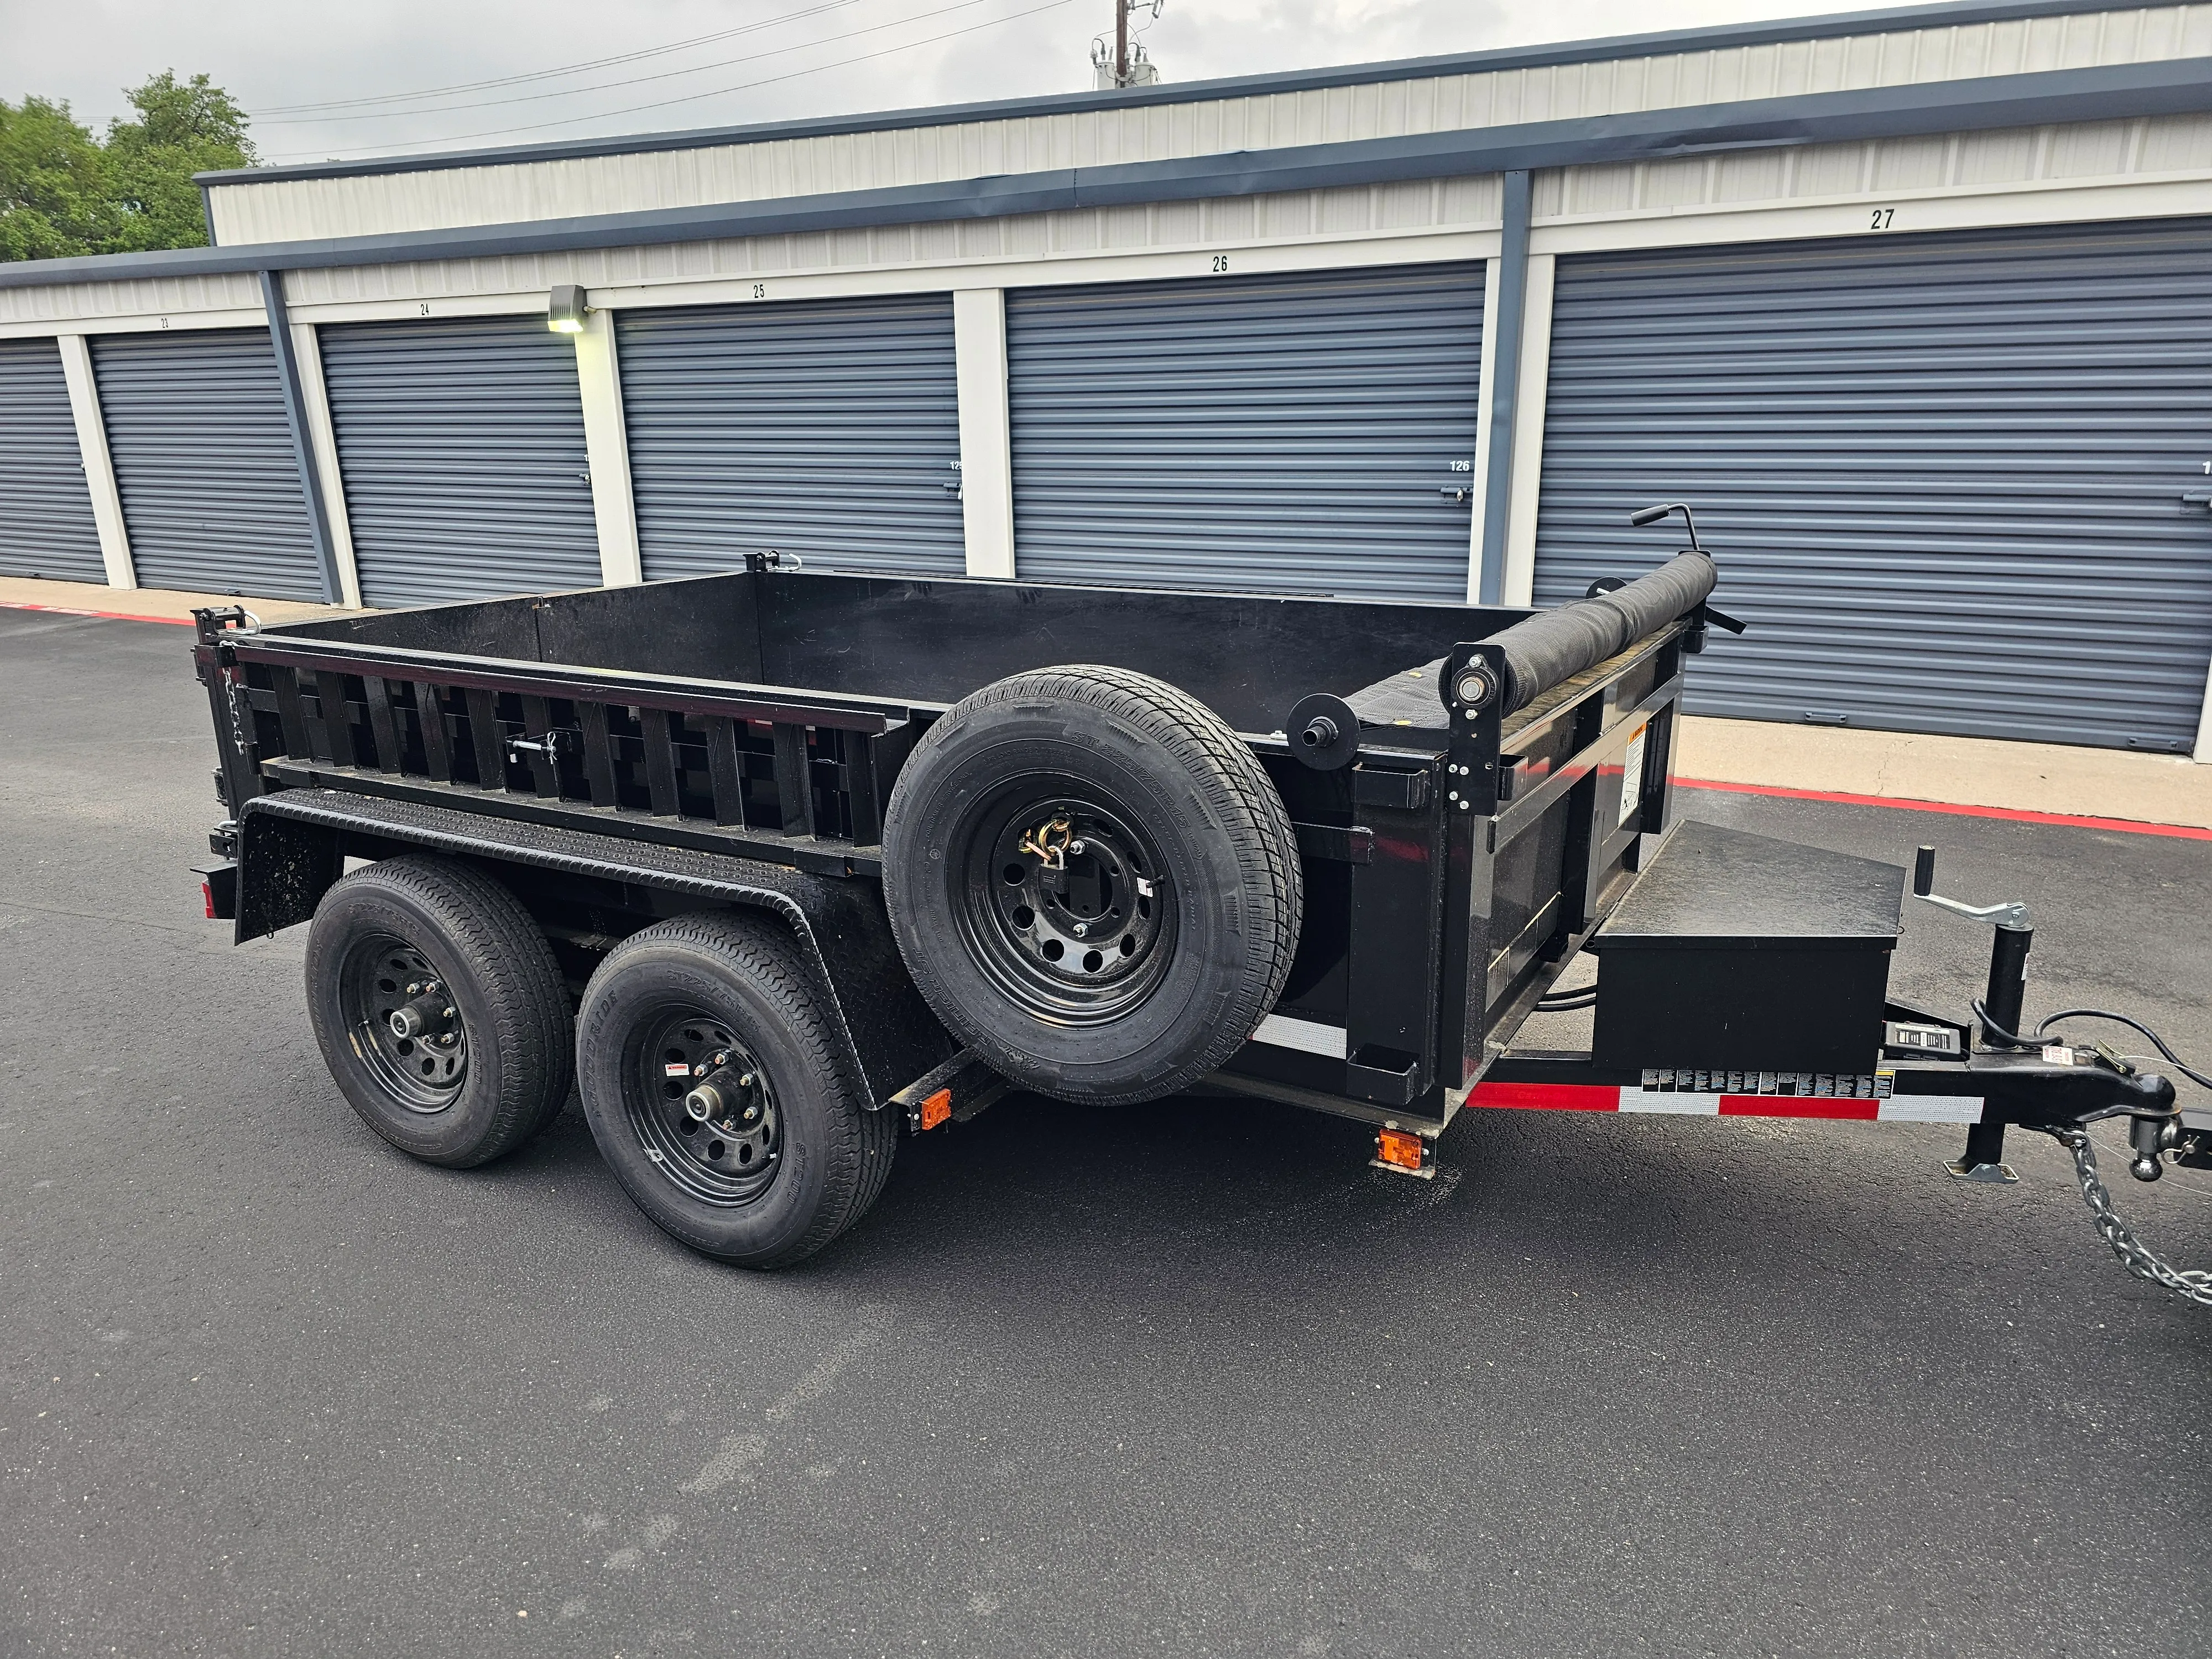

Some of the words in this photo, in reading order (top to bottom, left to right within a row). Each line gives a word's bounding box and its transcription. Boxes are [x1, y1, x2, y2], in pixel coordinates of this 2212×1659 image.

[1871, 208, 1895, 229] 27
[1213, 255, 1227, 272] 26
[753, 284, 764, 298] 25
[420, 303, 429, 316] 24
[1449, 460, 1470, 471] 126
[1071, 731, 1099, 747] ST
[1100, 743, 1191, 828] 225/75R15
[585, 989, 617, 1106] GOODRIDE
[786, 1142, 806, 1204] ST200
